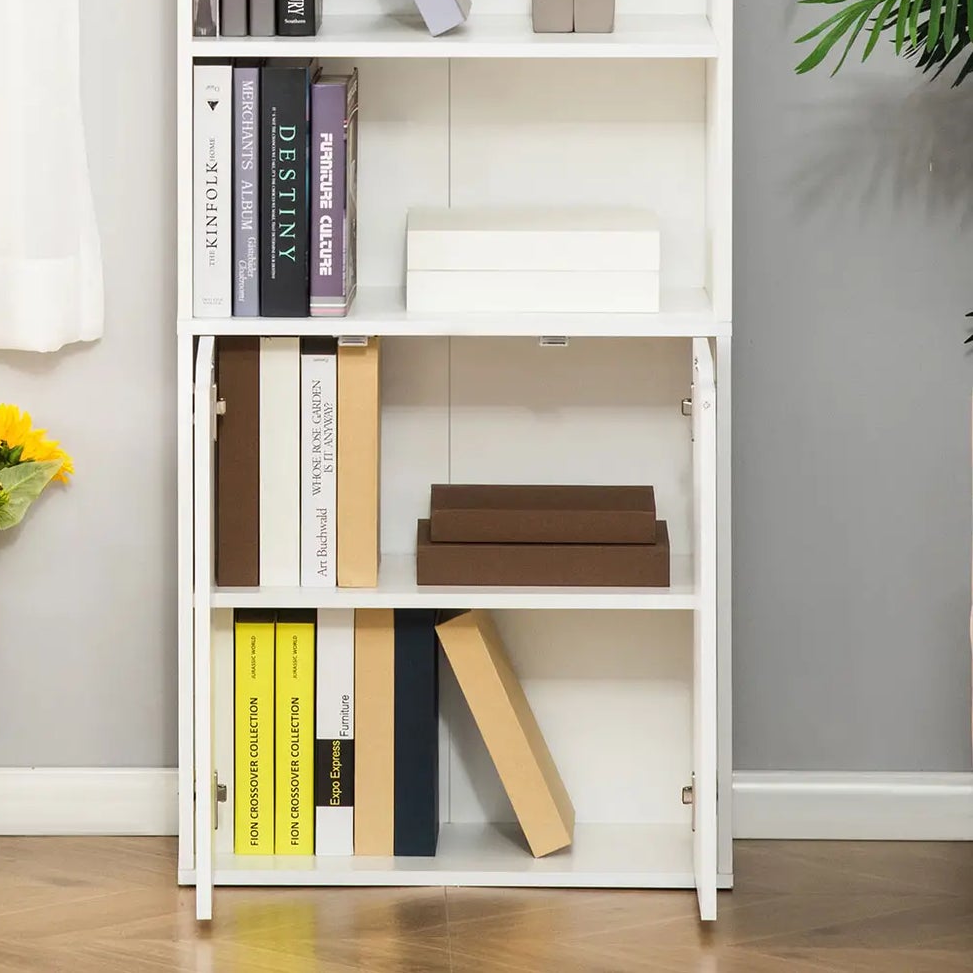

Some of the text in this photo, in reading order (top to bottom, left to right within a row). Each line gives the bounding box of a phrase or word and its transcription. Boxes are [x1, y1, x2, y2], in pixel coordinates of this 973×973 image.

[206, 162, 217, 248] KINFOLK
[241, 80, 254, 229] MERCHANTS ALBUM
[279, 125, 296, 262] DESTINY
[320, 133, 332, 275] FURNITURE CULTURE
[312, 380, 322, 495] WHOSE ROSE GARDEN
[323, 402, 333, 473] IS IT ANYWAY?
[317, 508, 328, 577] Art Buchwald
[250, 697, 259, 846] FION CROSSOVER COLLECTION
[291, 697, 300, 846] FION CROSSOVER COLLECTION
[330, 740, 341, 805] Expo Express
[340, 695, 350, 737] Furniture
